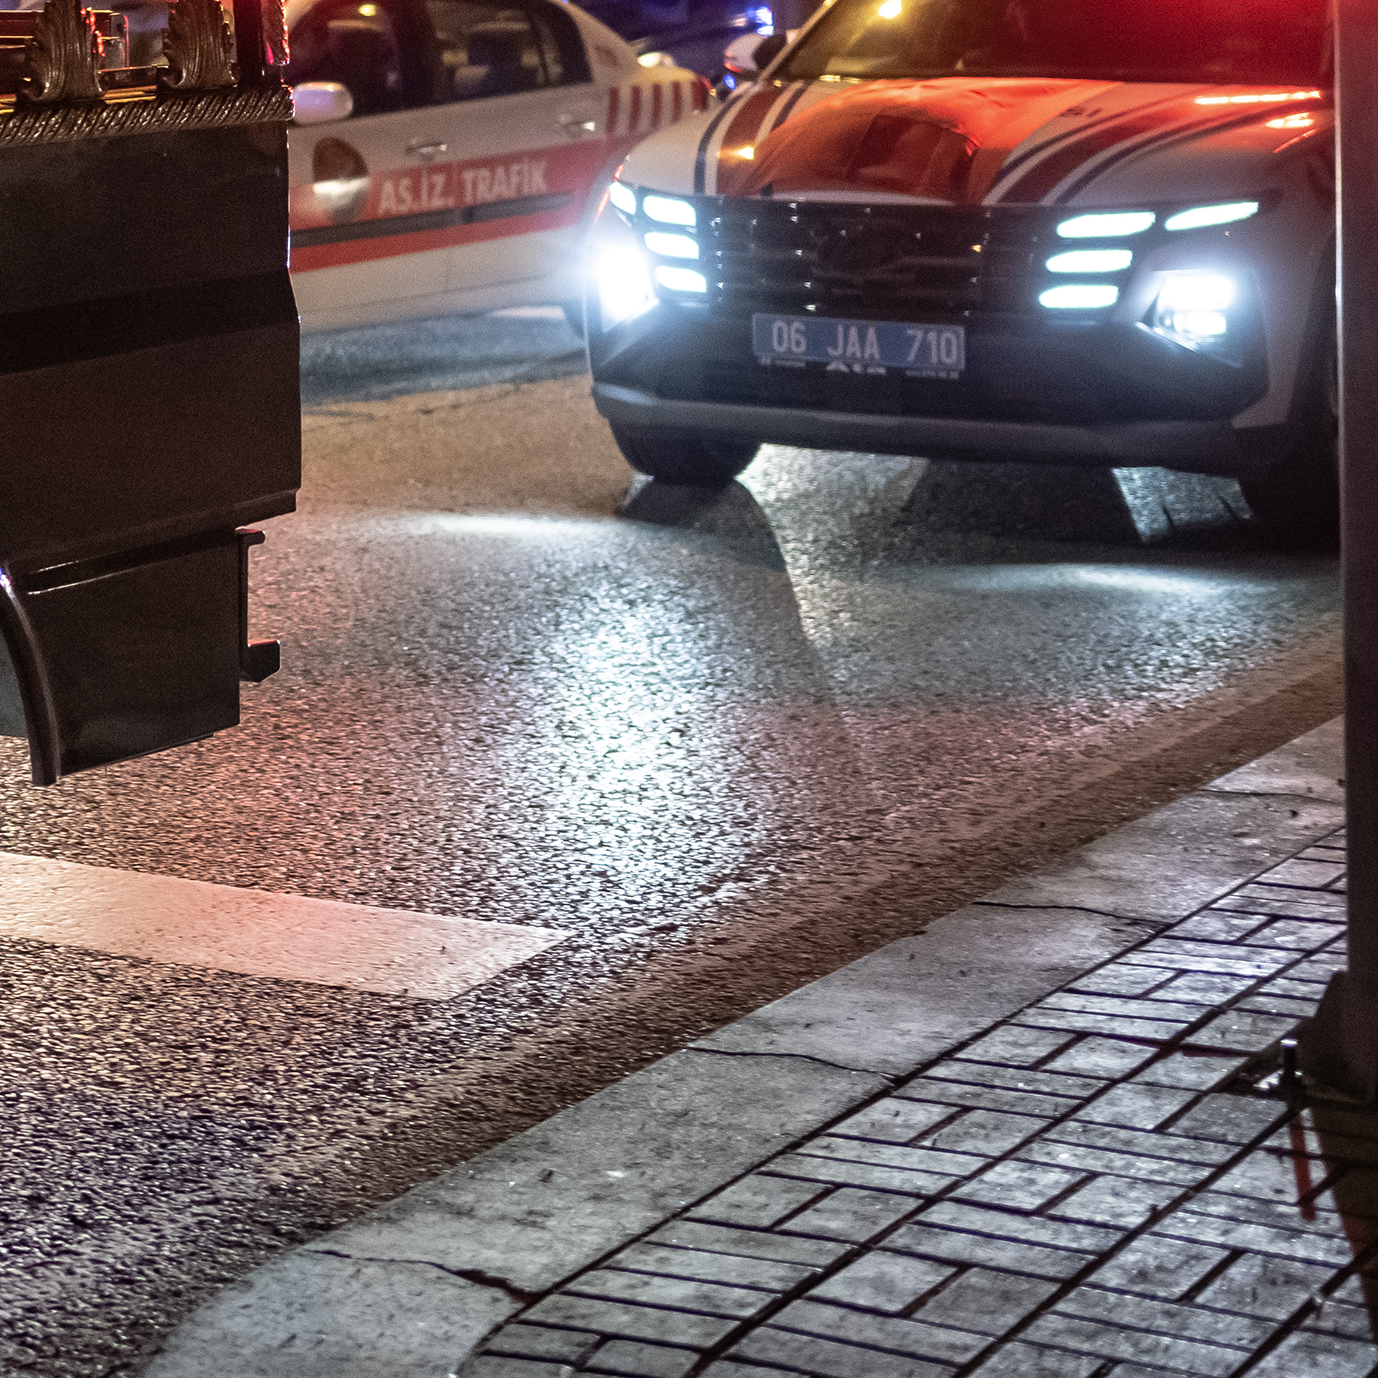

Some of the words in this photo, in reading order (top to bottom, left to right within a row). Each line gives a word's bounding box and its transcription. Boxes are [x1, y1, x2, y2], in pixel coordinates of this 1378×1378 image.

[461, 157, 546, 204] TRAFİK
[772, 320, 807, 354] 06
[827, 324, 880, 361] JAA
[906, 329, 958, 364] 710
